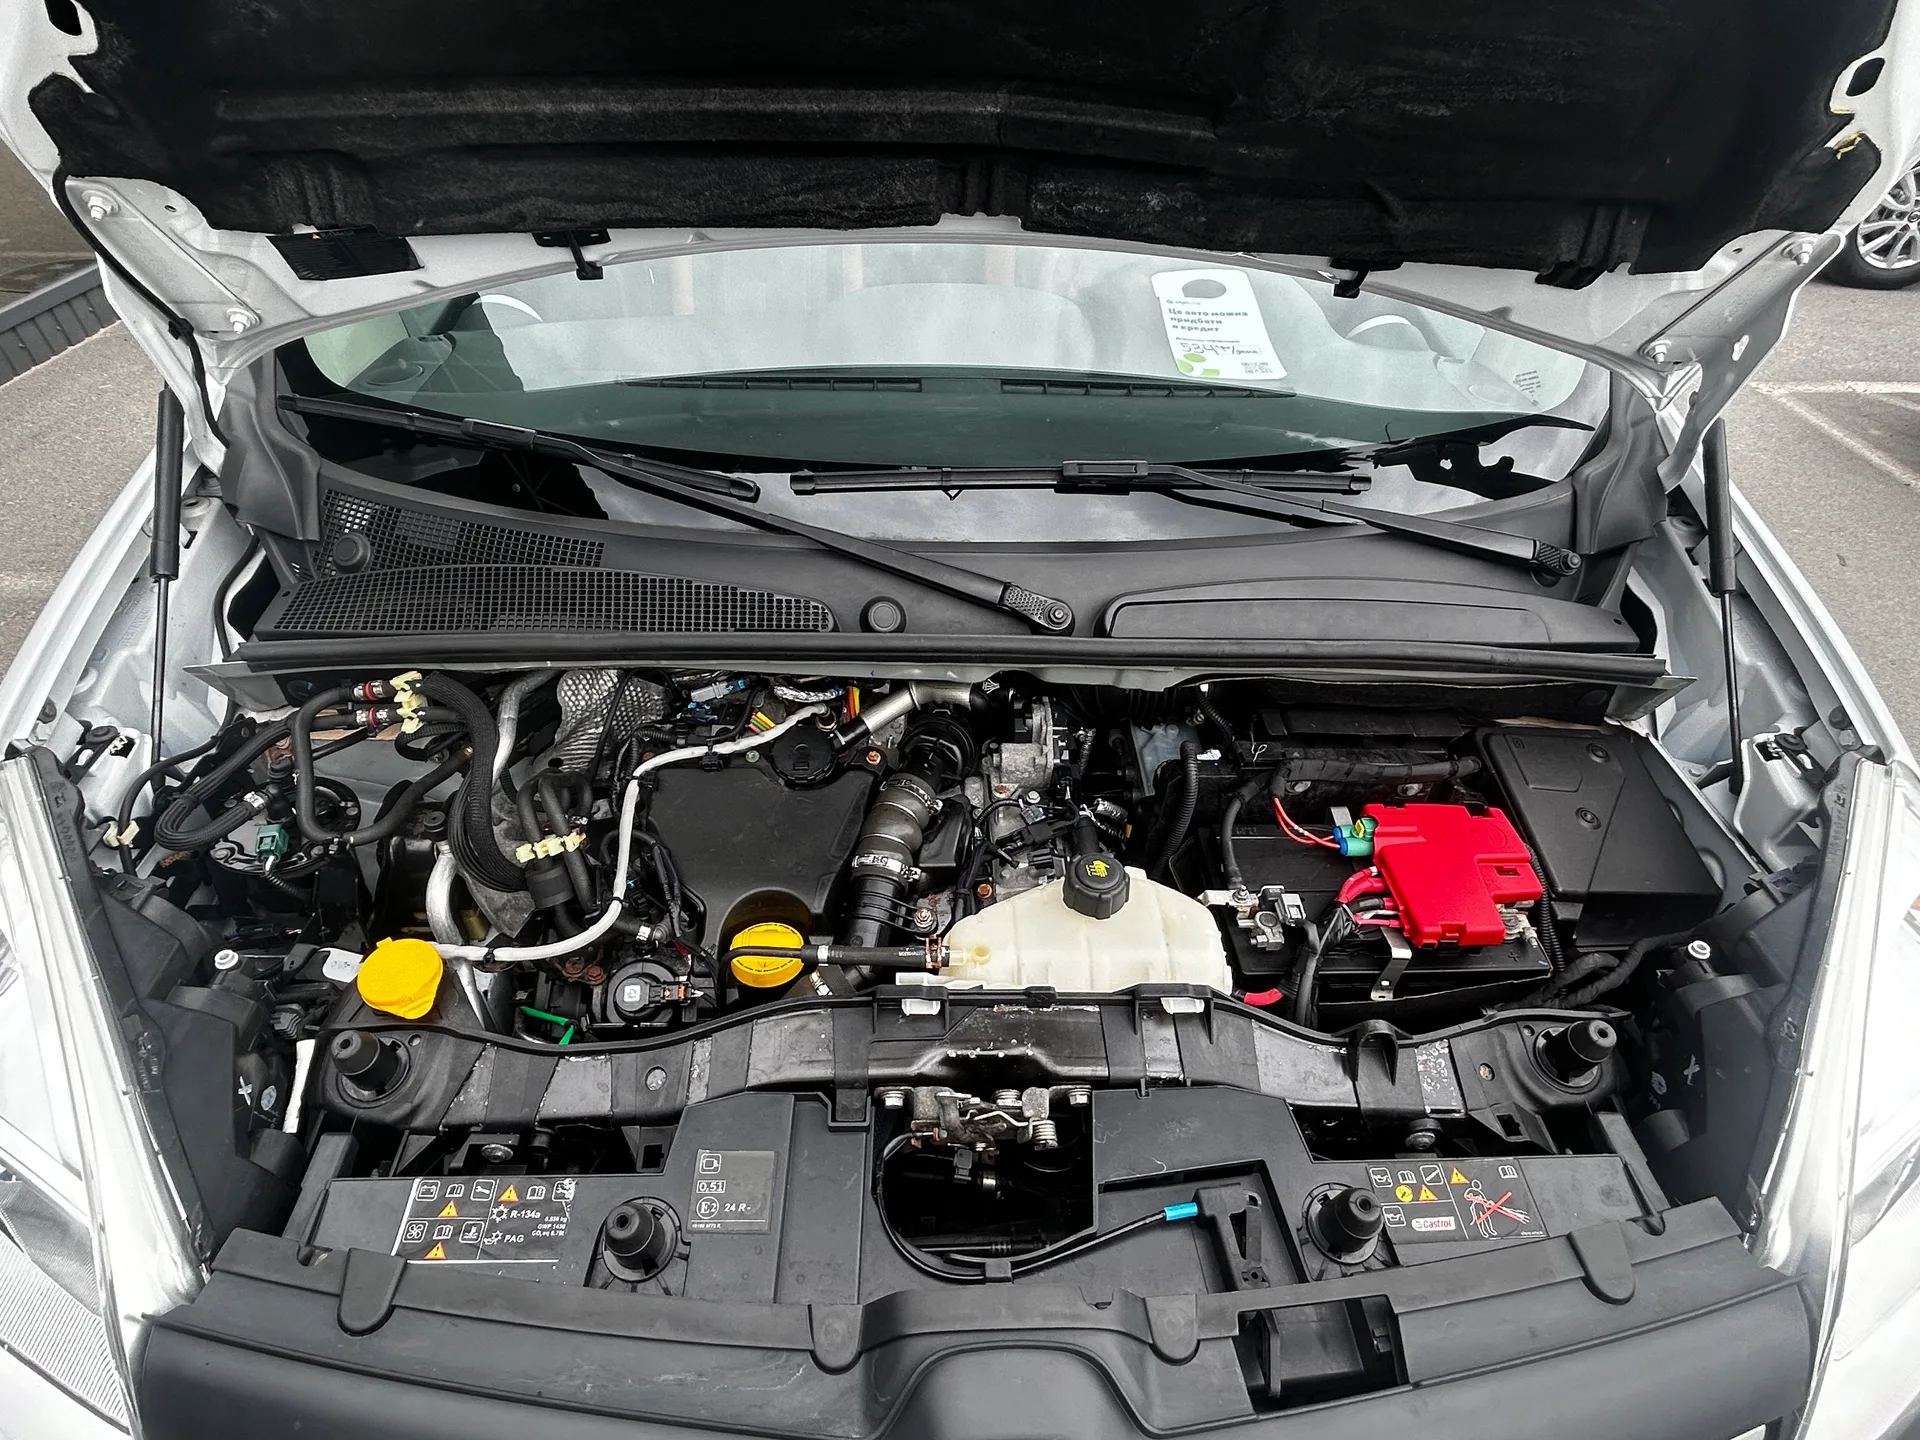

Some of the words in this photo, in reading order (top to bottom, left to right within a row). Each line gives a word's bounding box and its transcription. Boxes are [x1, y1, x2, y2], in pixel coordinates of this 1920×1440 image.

[1170, 316, 1223, 325] придбати
[699, 1182, 723, 1193] 0,51
[724, 1203, 736, 1212] 24
[510, 1209, 541, 1219] R-134a
[1423, 1219, 1452, 1229] Castrol
[504, 1234, 525, 1243] PAG
